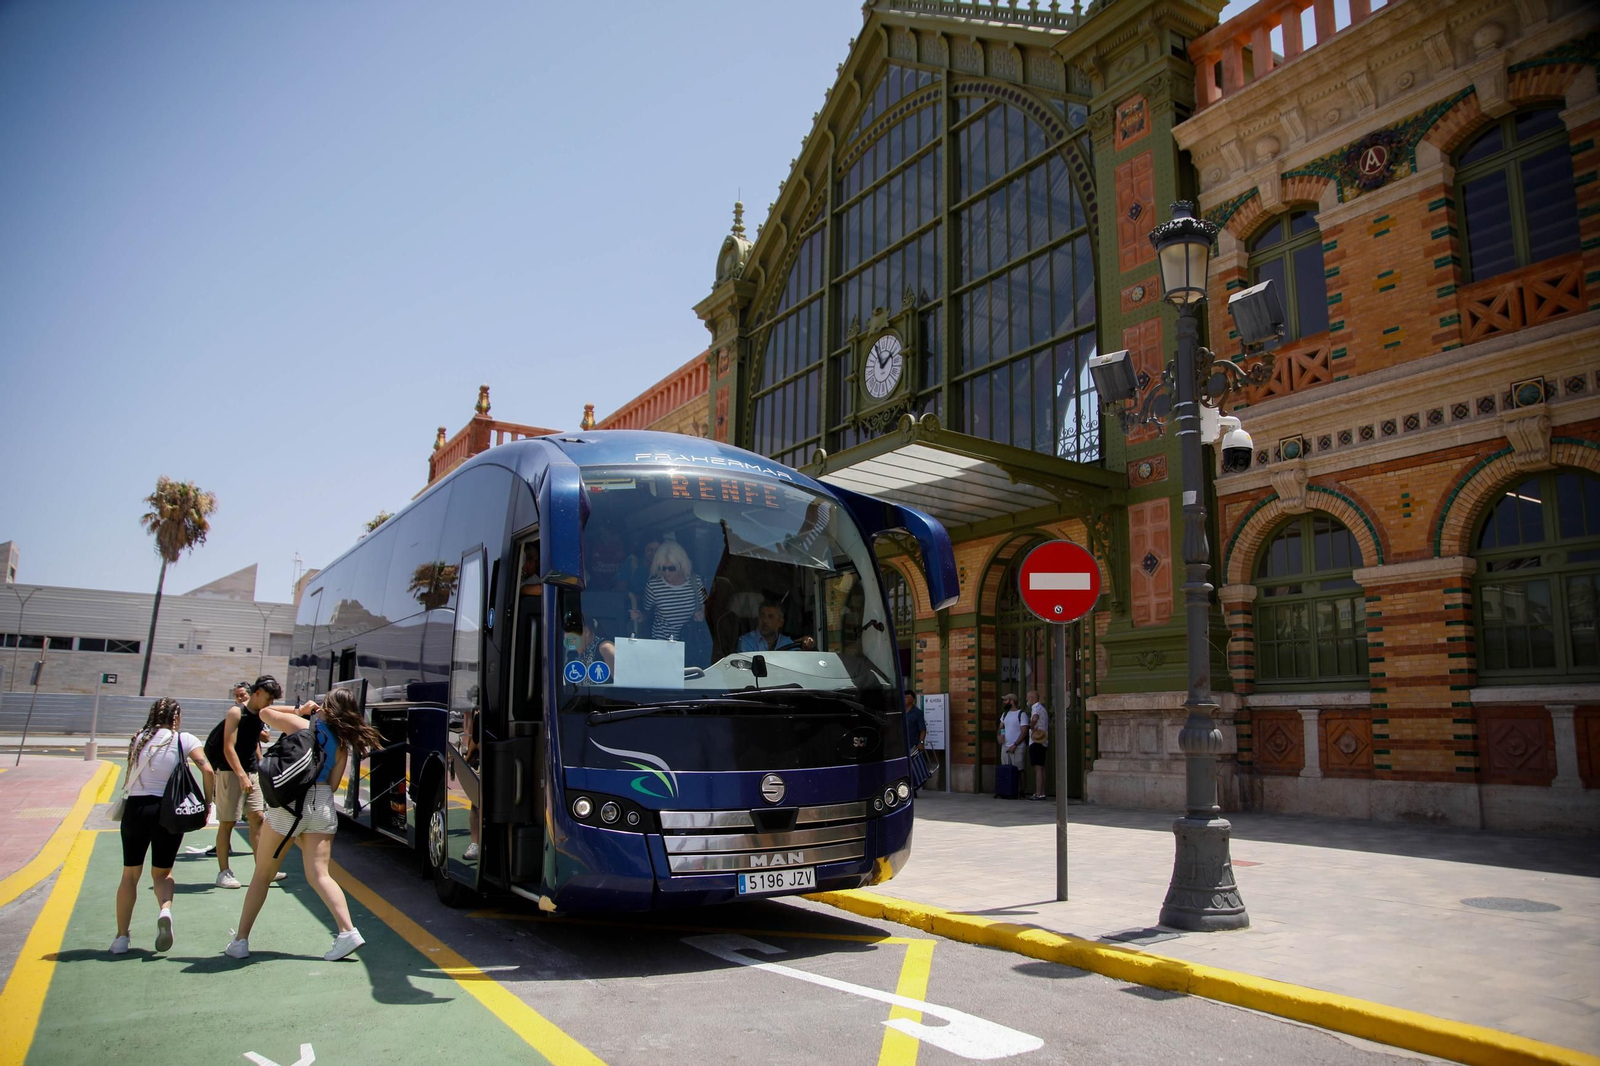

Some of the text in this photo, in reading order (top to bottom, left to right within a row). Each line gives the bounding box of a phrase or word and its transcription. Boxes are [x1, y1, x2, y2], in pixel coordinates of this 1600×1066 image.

[635, 453, 792, 481] FRAHERMAR
[670, 475, 779, 508] RENFE
[853, 736, 868, 748] SC7
[175, 804, 205, 815] adidas
[750, 851, 804, 868] MAN
[749, 873, 784, 890] 5196
[789, 870, 812, 887] JZV
